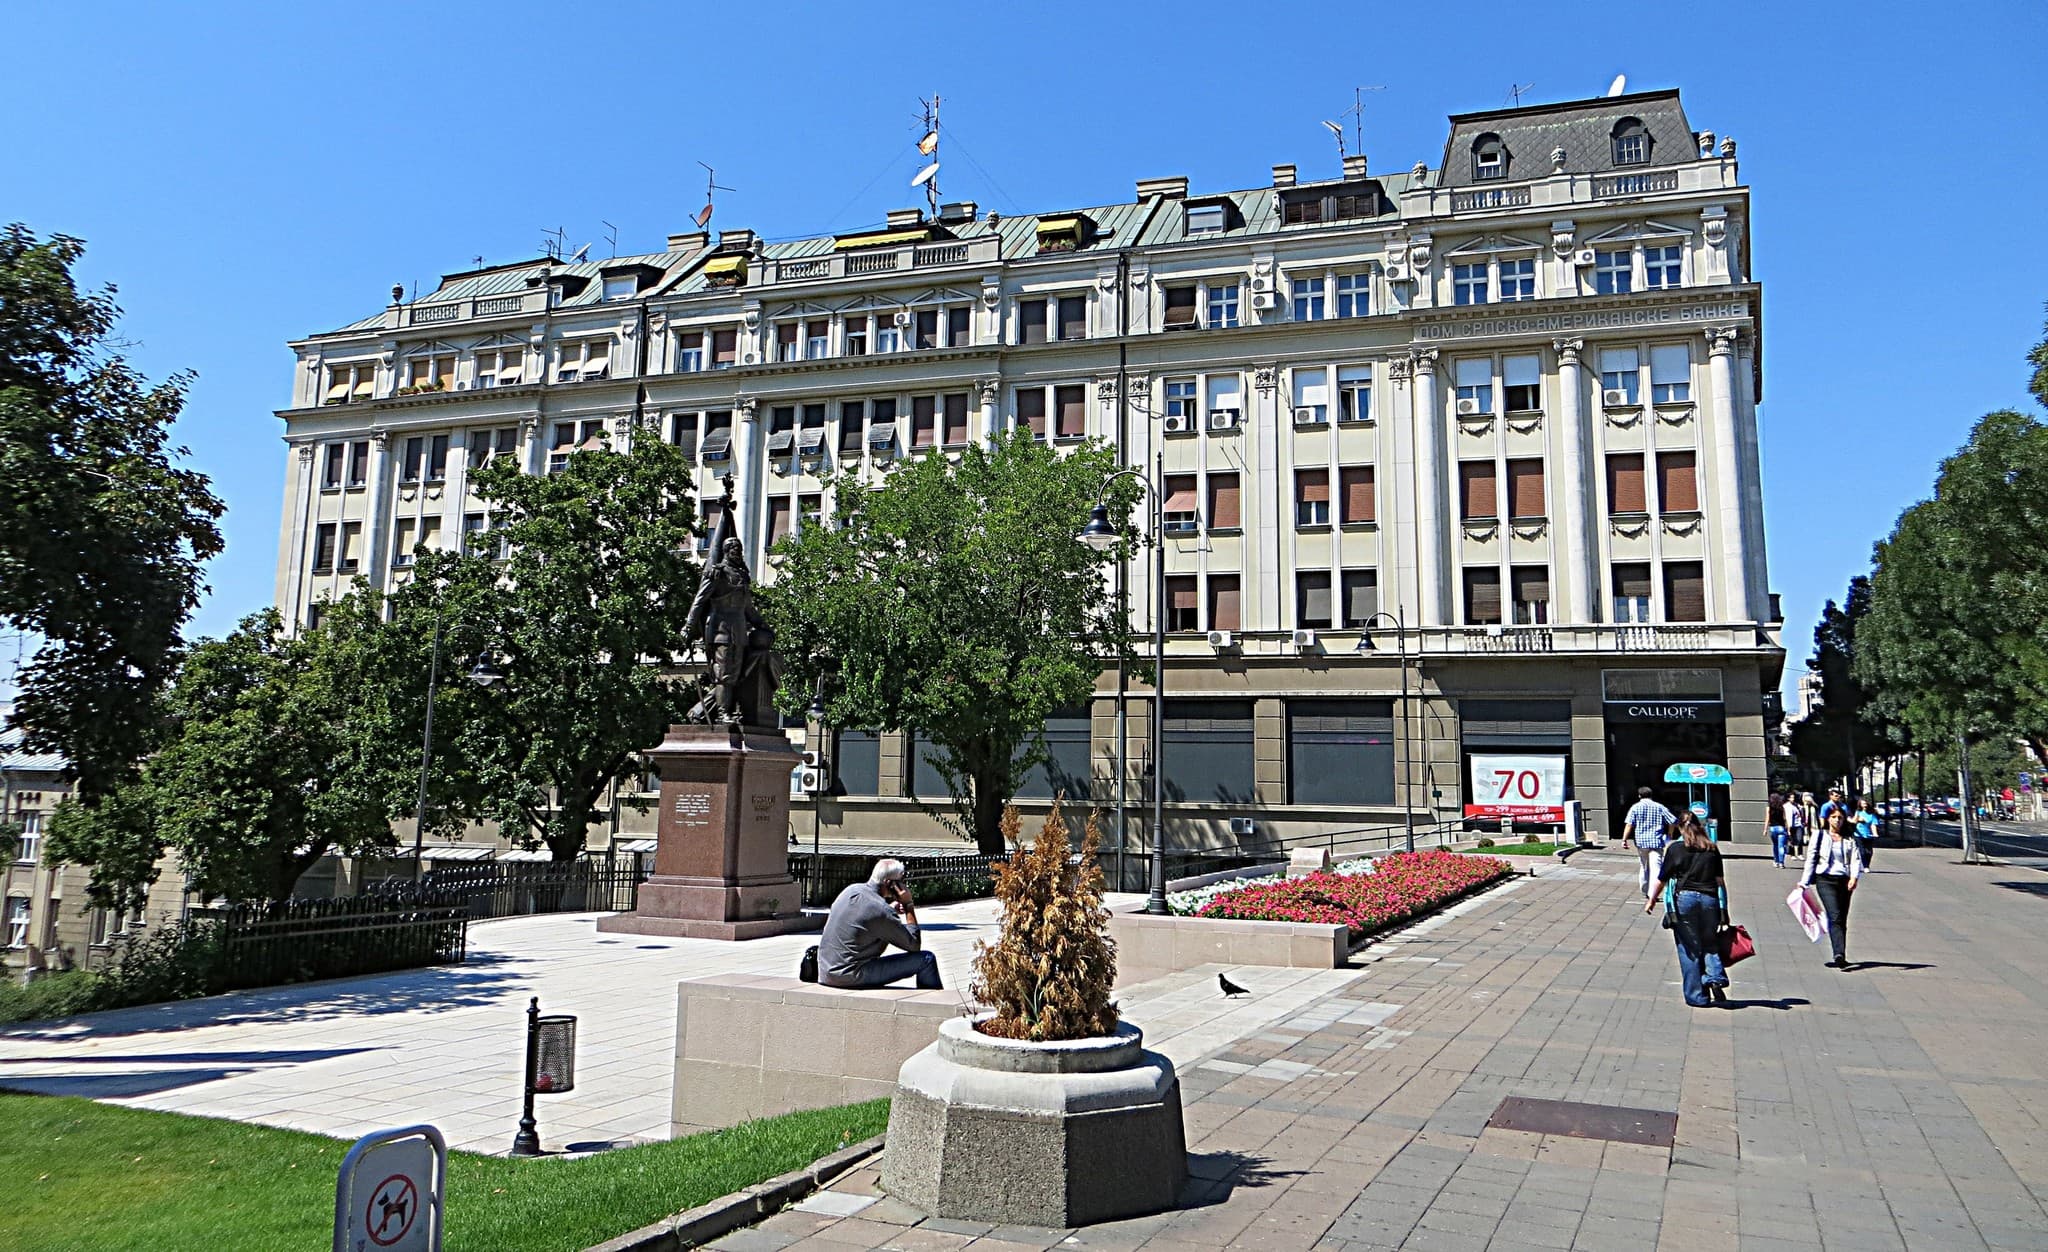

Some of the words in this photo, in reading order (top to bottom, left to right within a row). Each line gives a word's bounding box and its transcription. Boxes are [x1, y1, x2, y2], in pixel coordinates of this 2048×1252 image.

[1419, 325, 1454, 339] ДОМ
[1461, 307, 1670, 337] СРПСКО-АМЕРИКАНСКЕ
[1680, 303, 1742, 321] БАНКЕ
[1628, 706, 1699, 717] CALLIOPE
